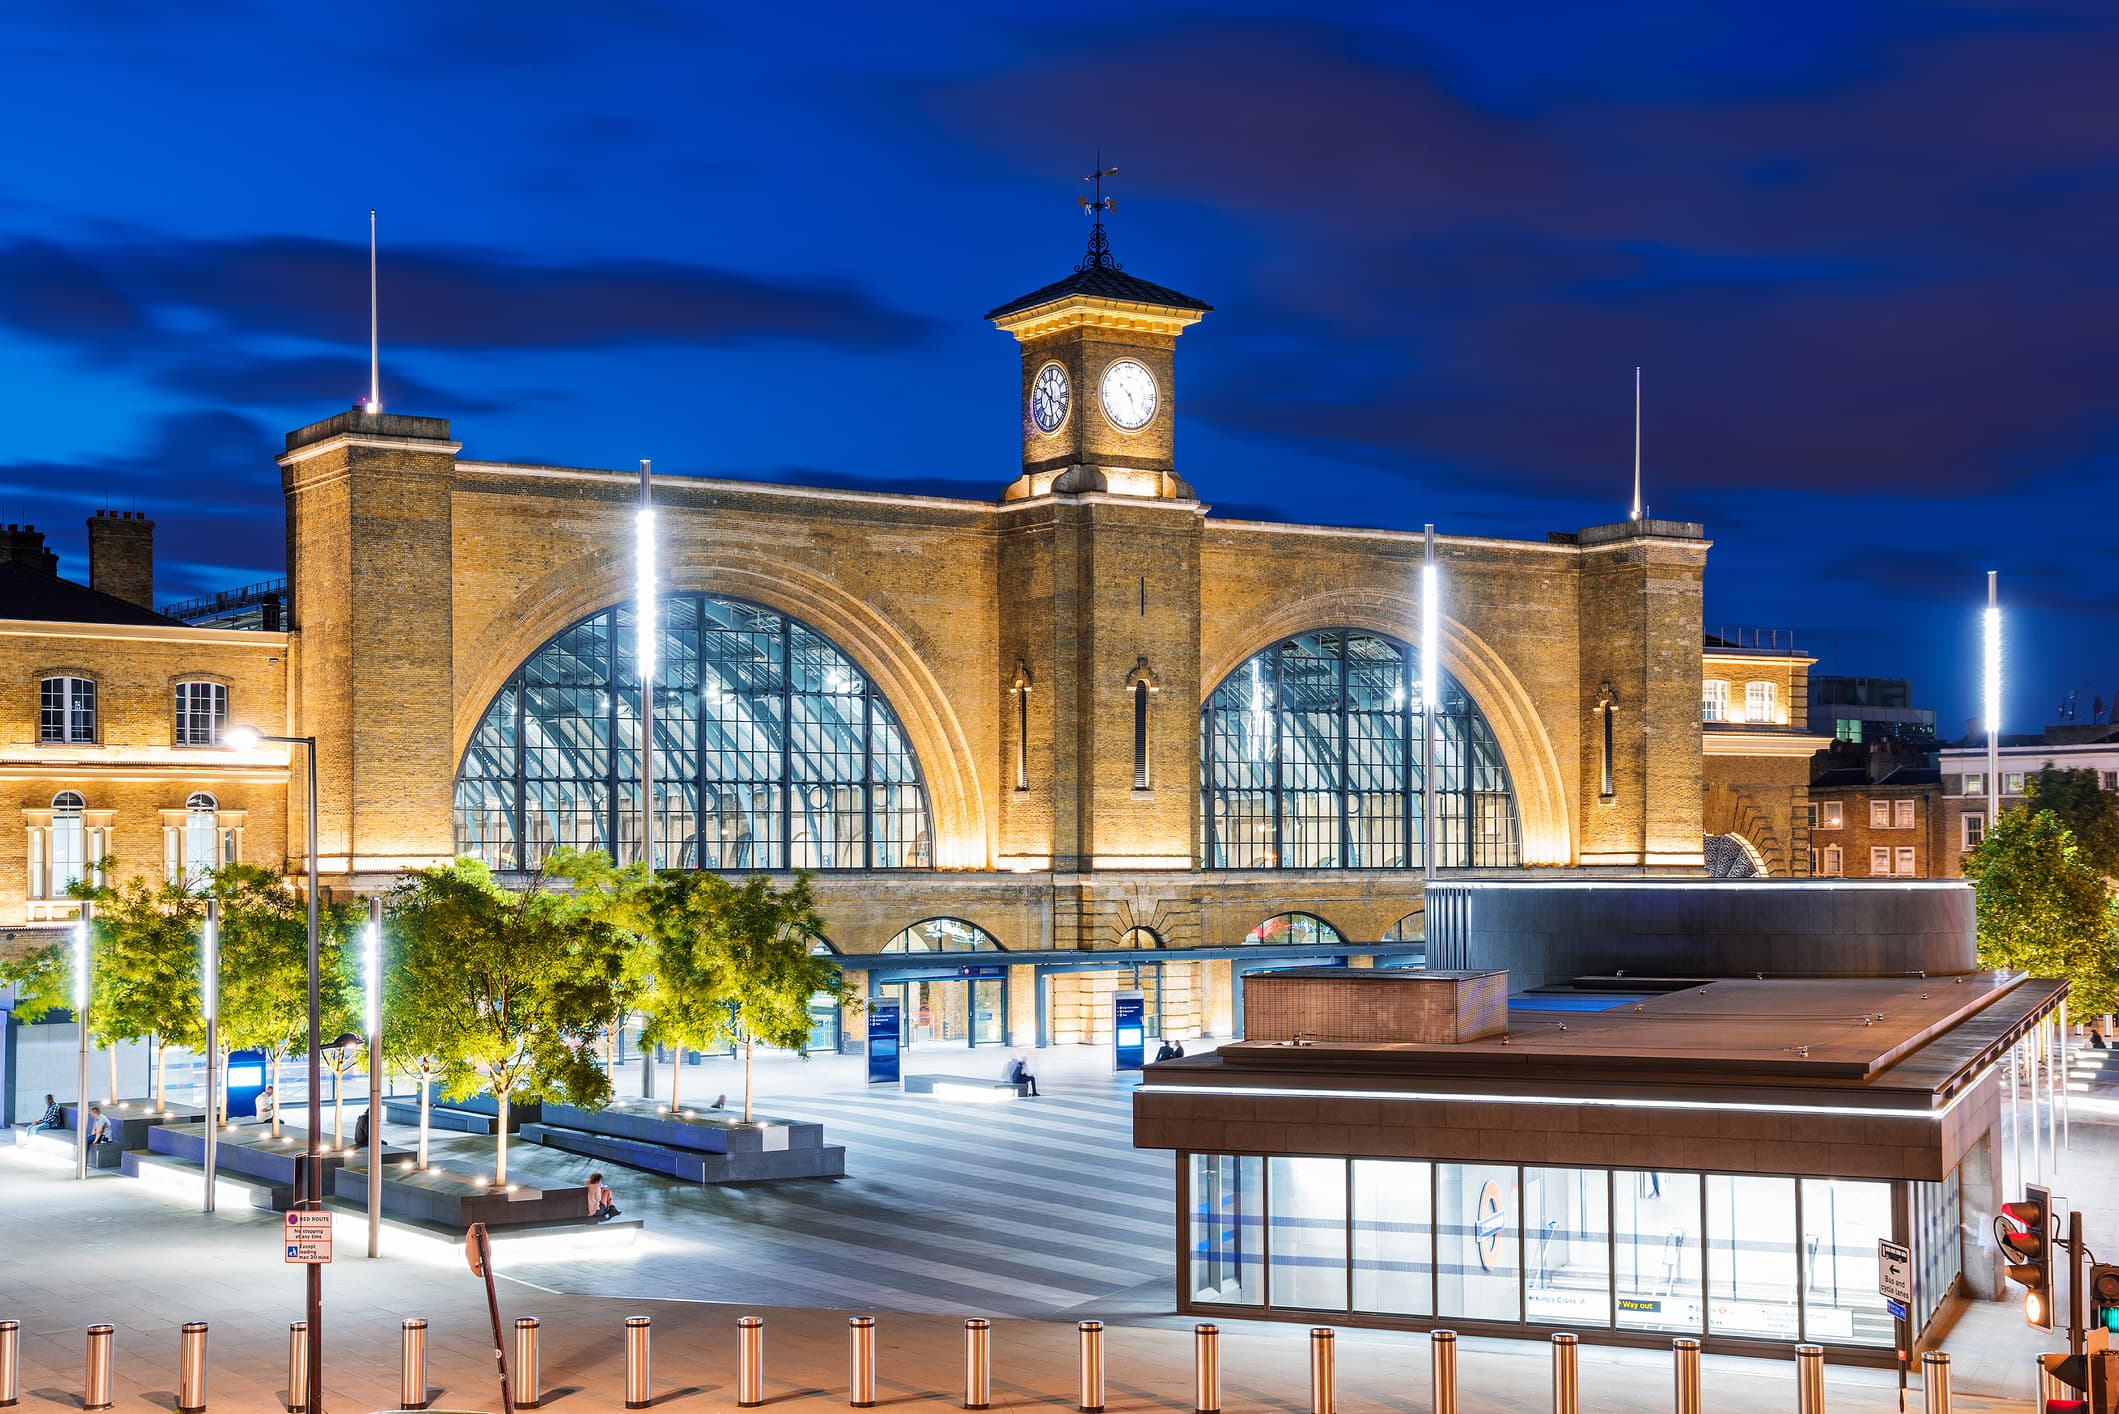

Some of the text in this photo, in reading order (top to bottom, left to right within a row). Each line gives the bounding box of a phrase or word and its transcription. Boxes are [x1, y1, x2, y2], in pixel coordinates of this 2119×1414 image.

[1884, 1274, 1905, 1288] Bus and
[1881, 1284, 1909, 1299] cycle lanes
[1622, 1300, 1654, 1310] Way out
